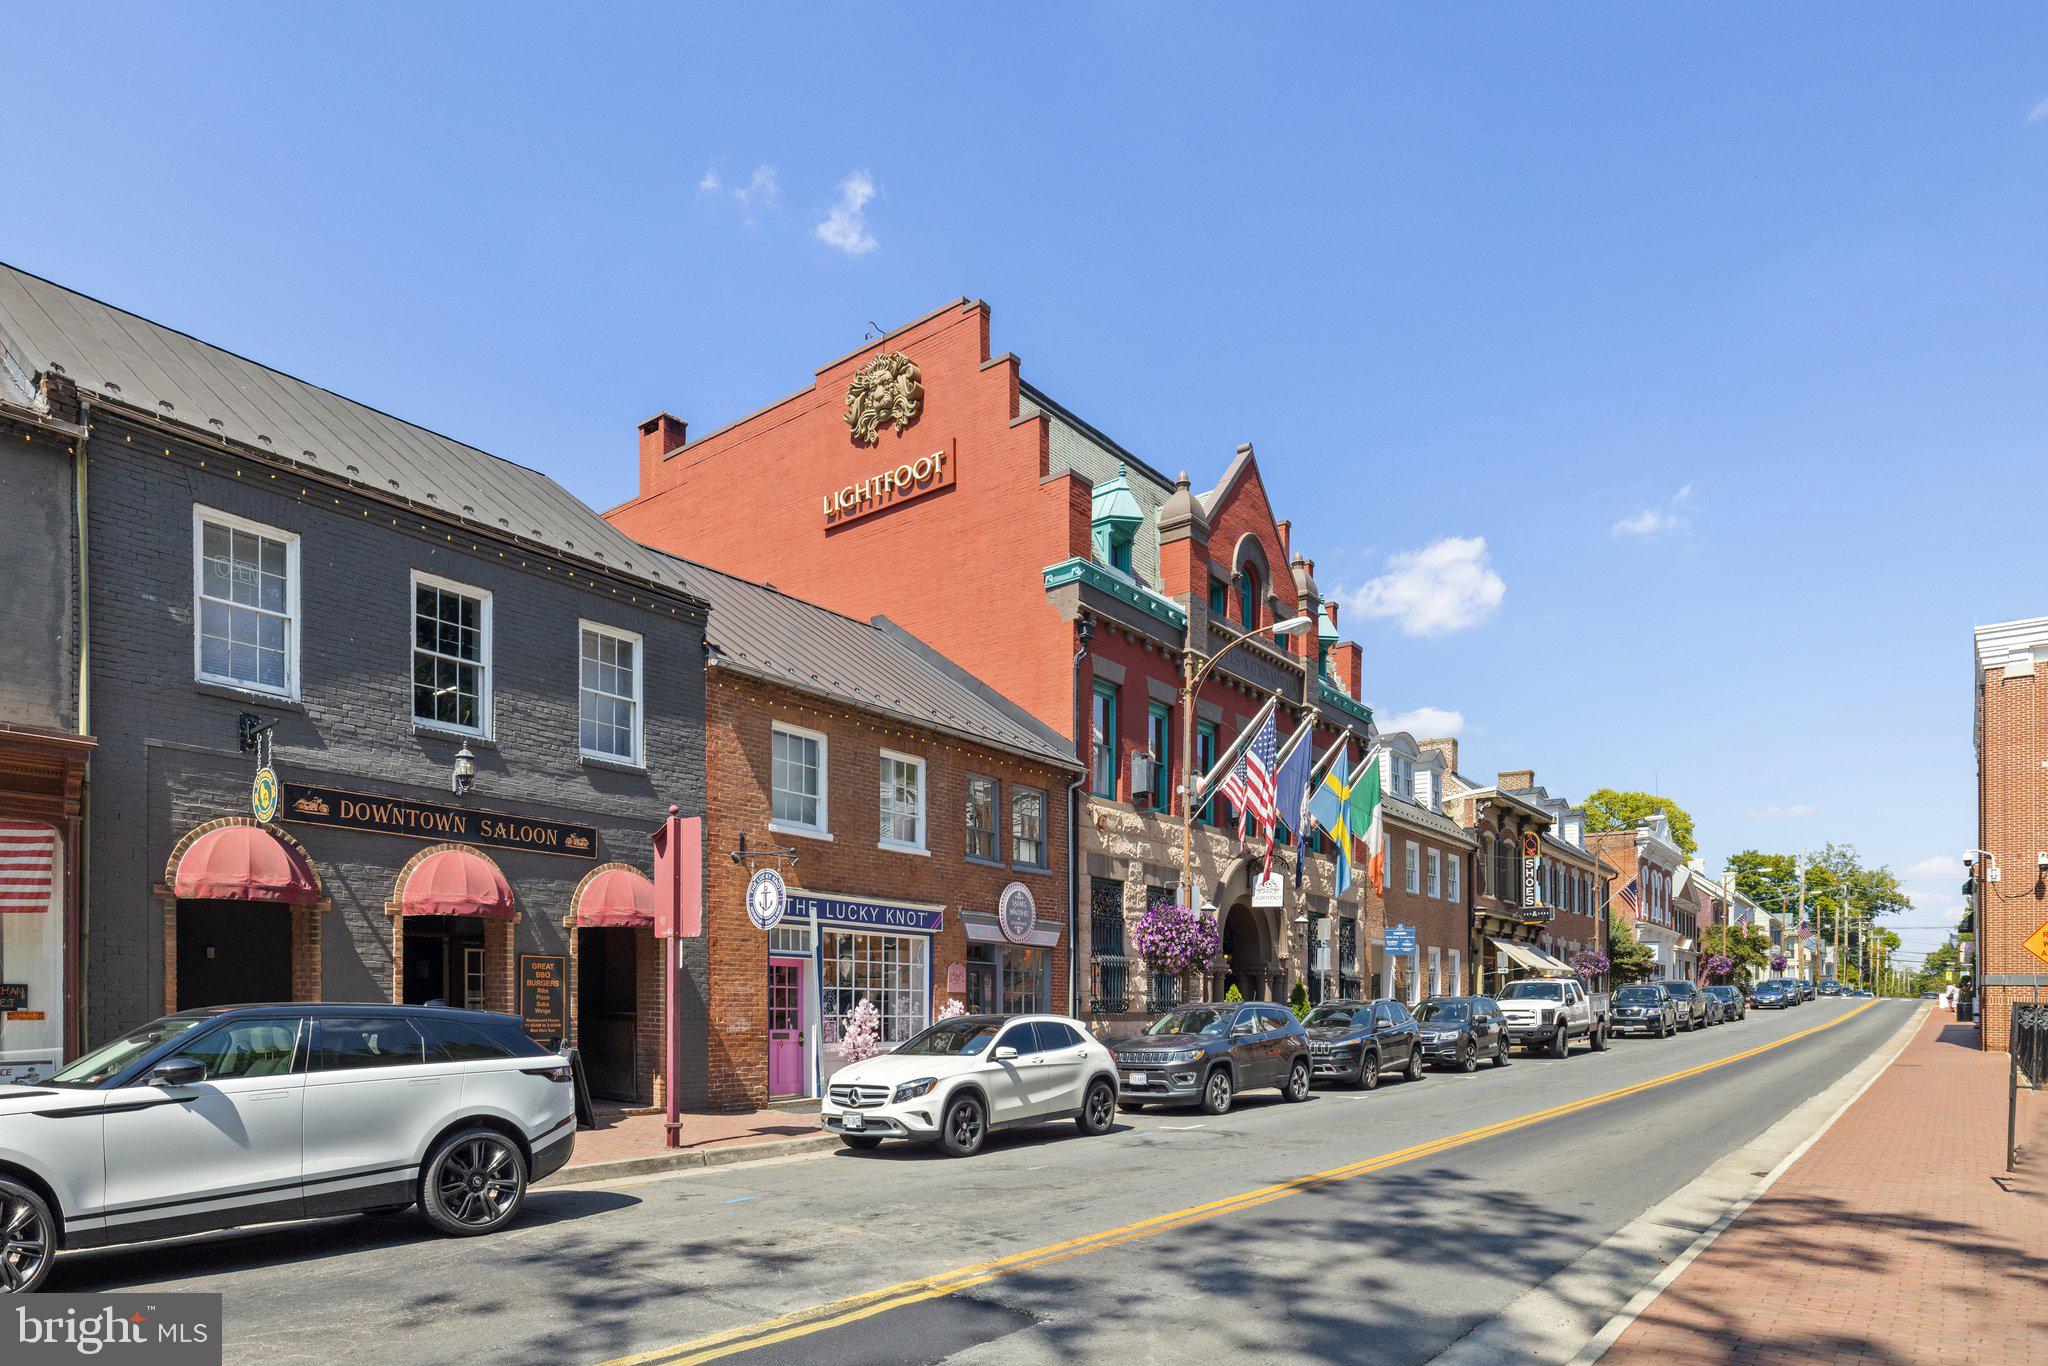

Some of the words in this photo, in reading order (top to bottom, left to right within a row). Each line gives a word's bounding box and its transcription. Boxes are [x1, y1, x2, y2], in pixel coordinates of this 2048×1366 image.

[823, 450, 944, 515] LIGHTFOOT
[340, 799, 466, 833] DOWNTOWN
[481, 820, 558, 845] SALOON
[1525, 859, 1534, 905] SHOES
[826, 902, 879, 921] LUCKY
[779, 1040, 784, 1048] 9
